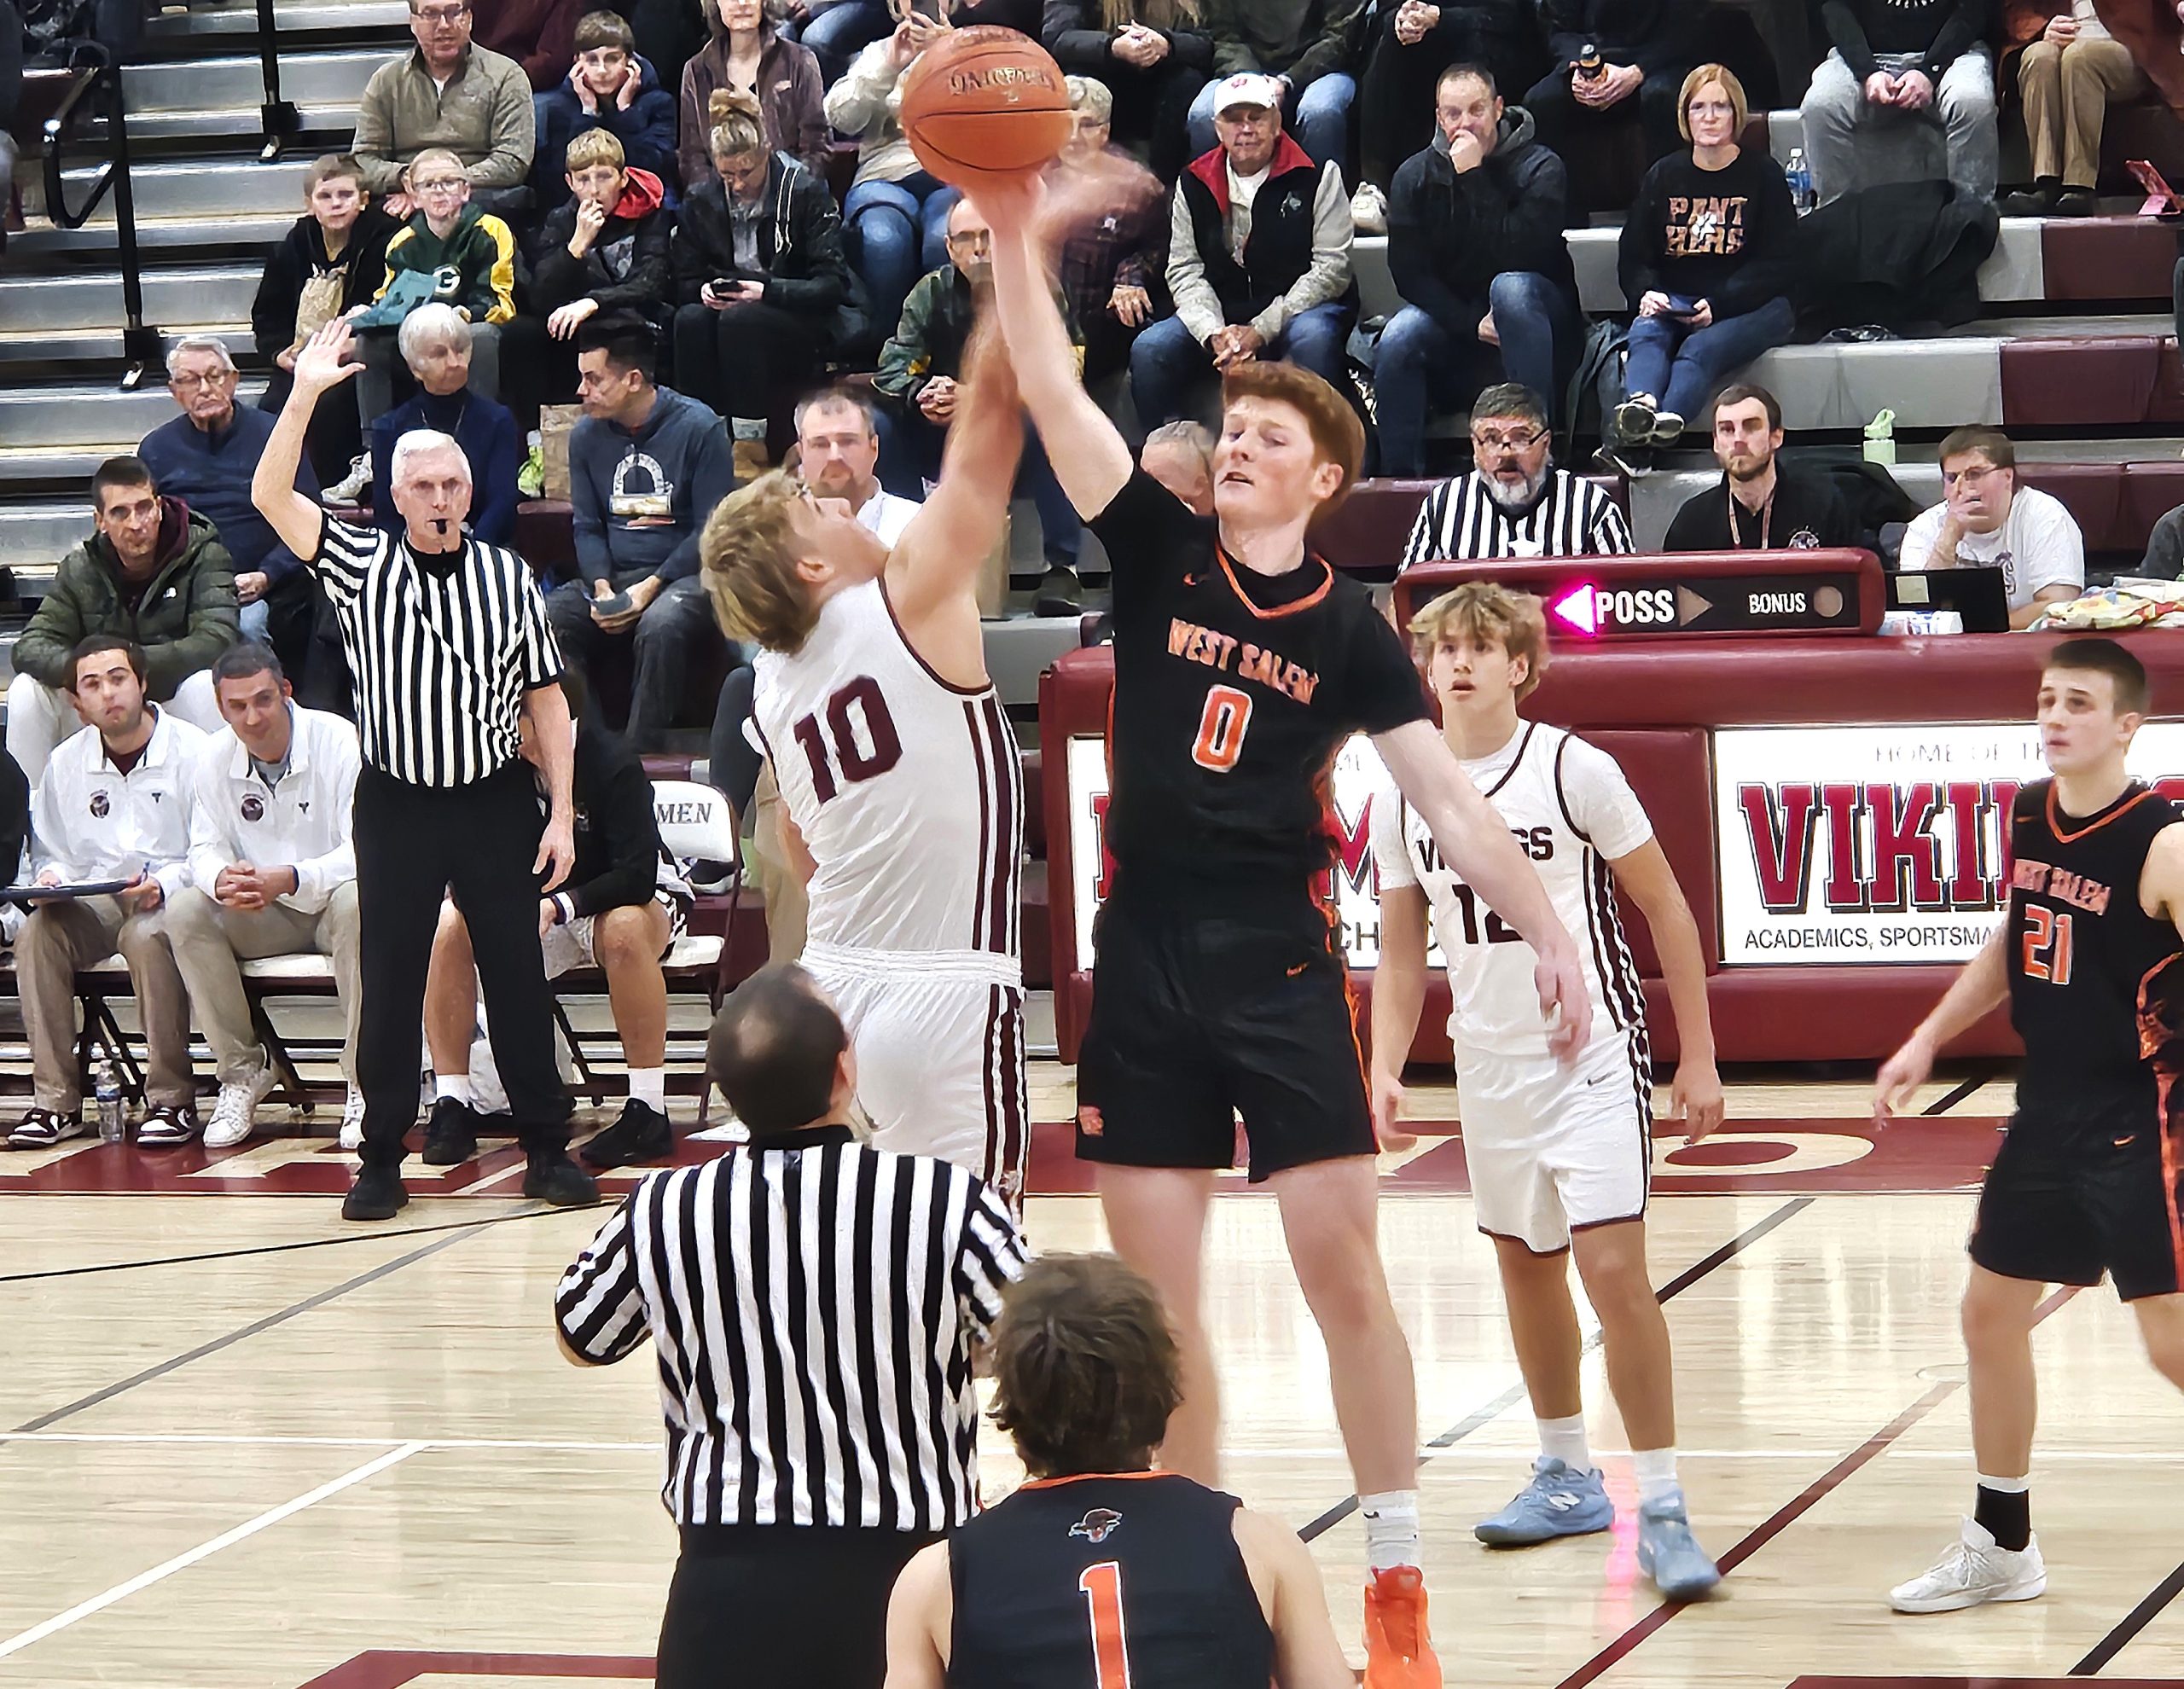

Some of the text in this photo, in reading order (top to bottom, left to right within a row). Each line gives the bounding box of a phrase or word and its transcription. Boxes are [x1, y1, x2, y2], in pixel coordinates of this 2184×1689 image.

[1595, 589, 1676, 624] POSS
[1748, 592, 1807, 615] BONUS
[793, 674, 903, 805] 10
[1191, 683, 1253, 774] 0
[1876, 744, 1953, 763] HOME
[1737, 778, 2013, 913] VIKI
[1745, 927, 1873, 949] ACADEMICS,
[2022, 903, 2073, 986] 21
[1077, 1560, 1131, 1689] 1
